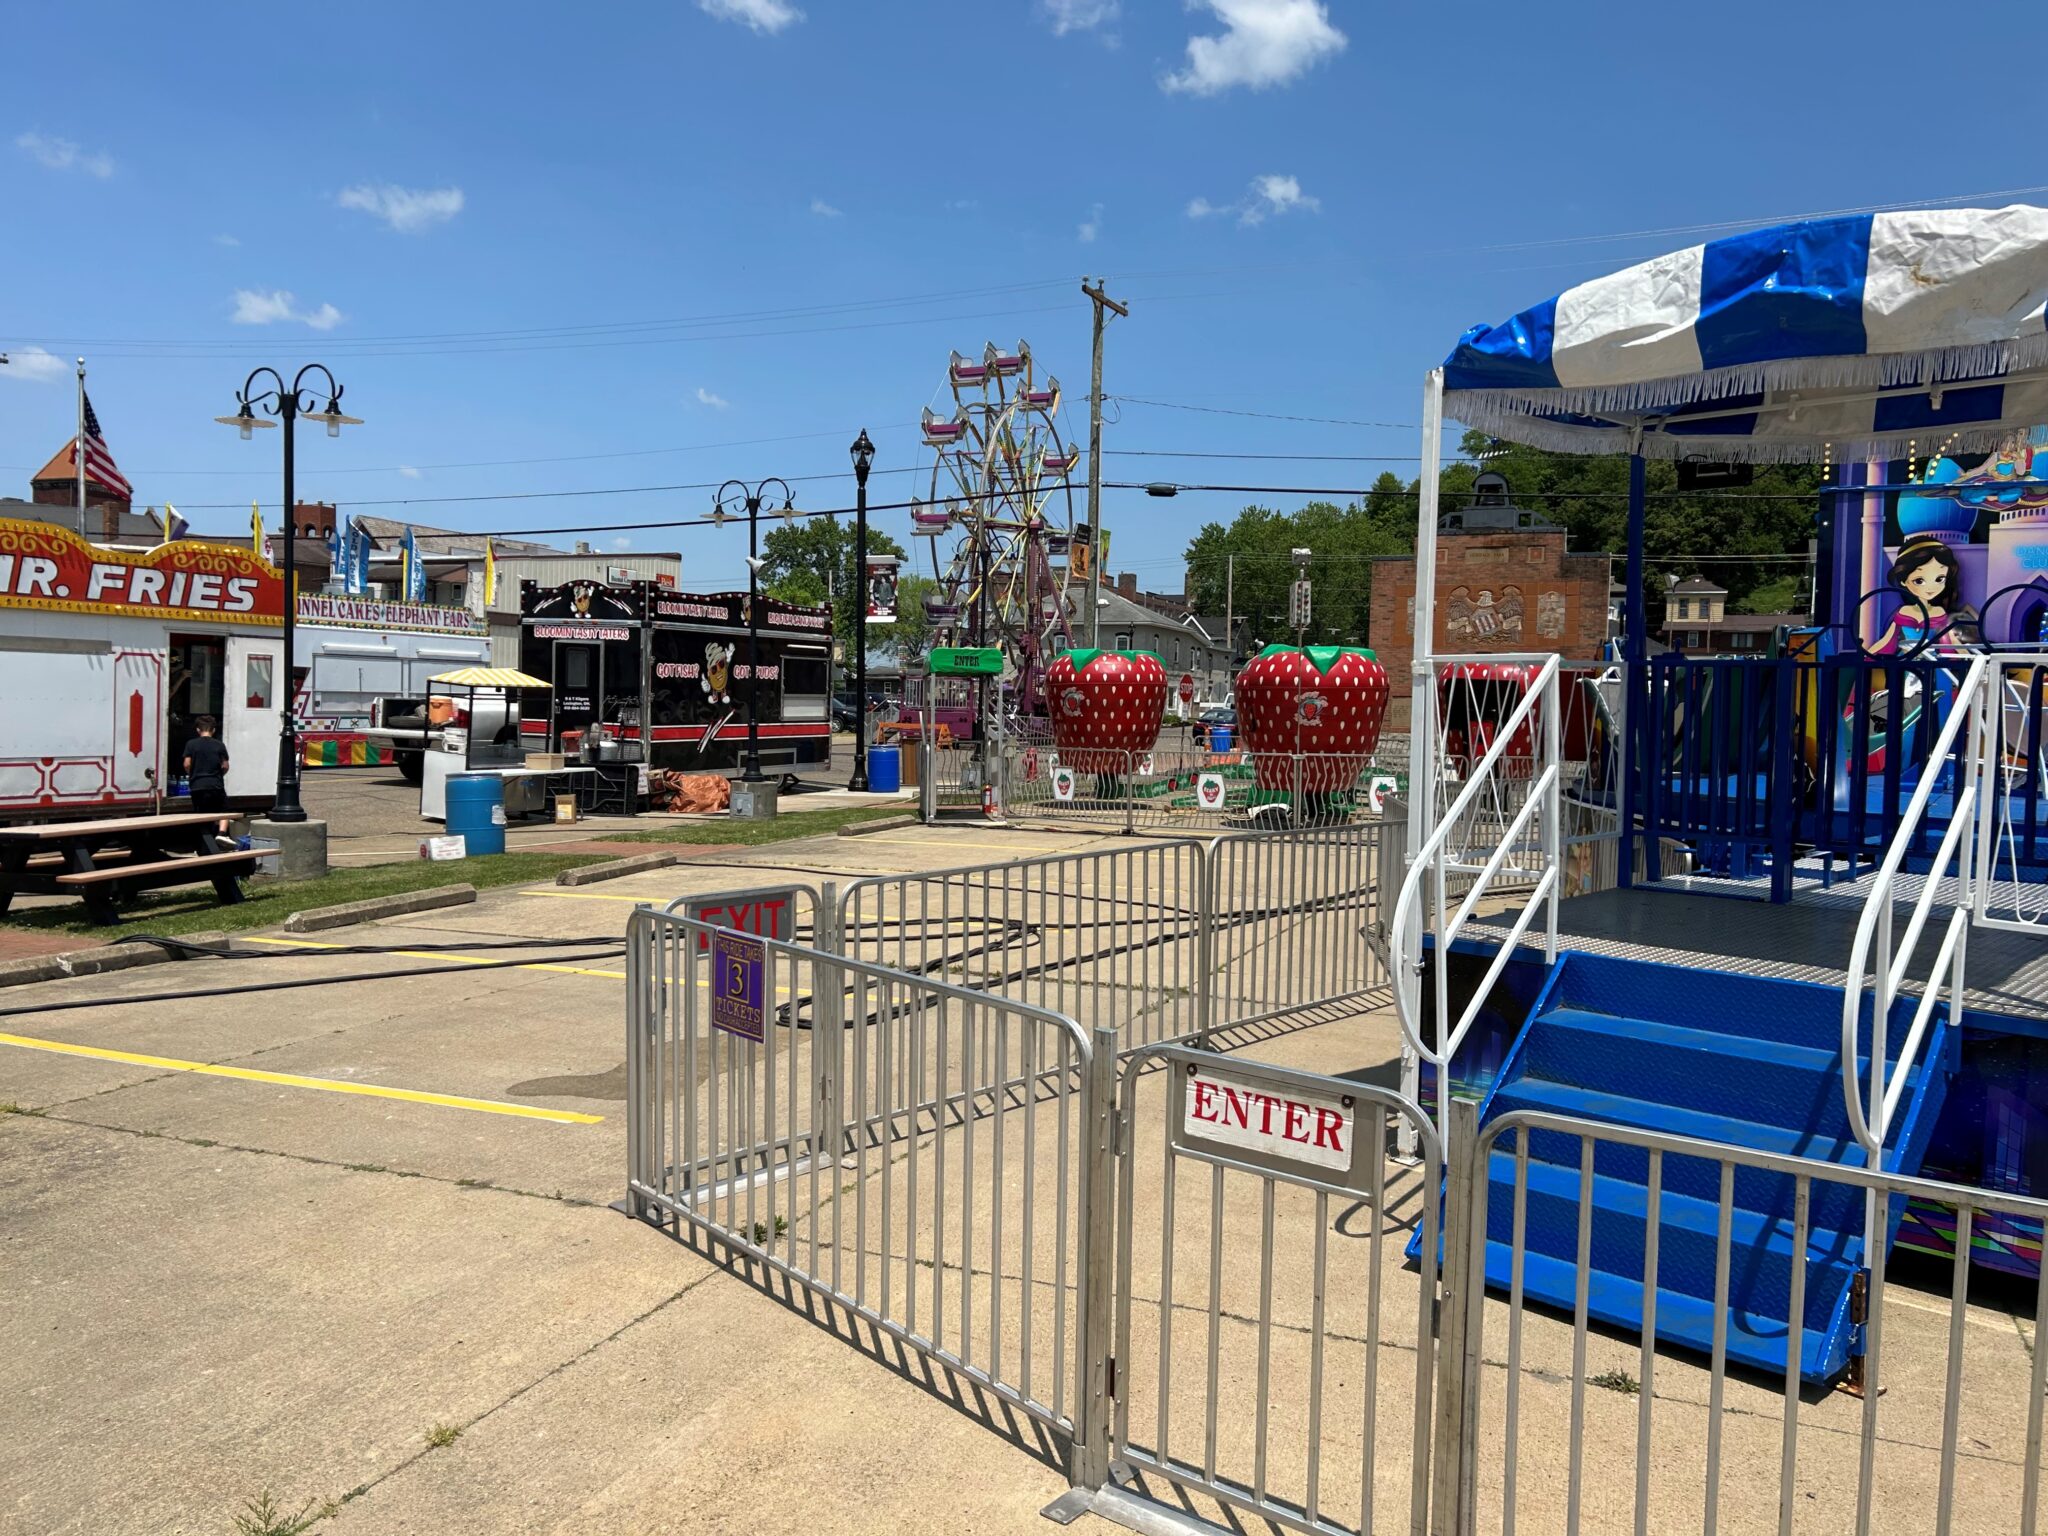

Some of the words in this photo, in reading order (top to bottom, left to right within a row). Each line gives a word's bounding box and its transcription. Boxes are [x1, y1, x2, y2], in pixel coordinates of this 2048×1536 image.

[86, 563, 259, 612] FRIES
[297, 598, 336, 618] NNEL
[337, 601, 380, 621] CAKES
[385, 605, 441, 625] ELEPHANT
[443, 610, 470, 628] EARS
[657, 601, 688, 616] BLOOMIN
[689, 604, 708, 617] TASTY
[708, 606, 728, 620] TATERS
[779, 613, 792, 626] FISH
[534, 626, 572, 639] BLOOMIN
[572, 627, 599, 639] TASTY
[599, 628, 630, 640] TATERS
[656, 663, 674, 679] GOT
[675, 663, 700, 679] FISH?
[954, 655, 979, 667] ENTER
[733, 664, 750, 680] GOT
[756, 665, 779, 680] PUDS?
[1180, 683, 1193, 694] STOP
[700, 900, 786, 949] EXIT
[717, 939, 729, 953] THIS
[729, 942, 743, 958] RIDE
[744, 945, 762, 962] TAKES
[730, 963, 744, 995] 3
[716, 997, 761, 1023] TICKETS
[1192, 1080, 1344, 1152] ENTER
